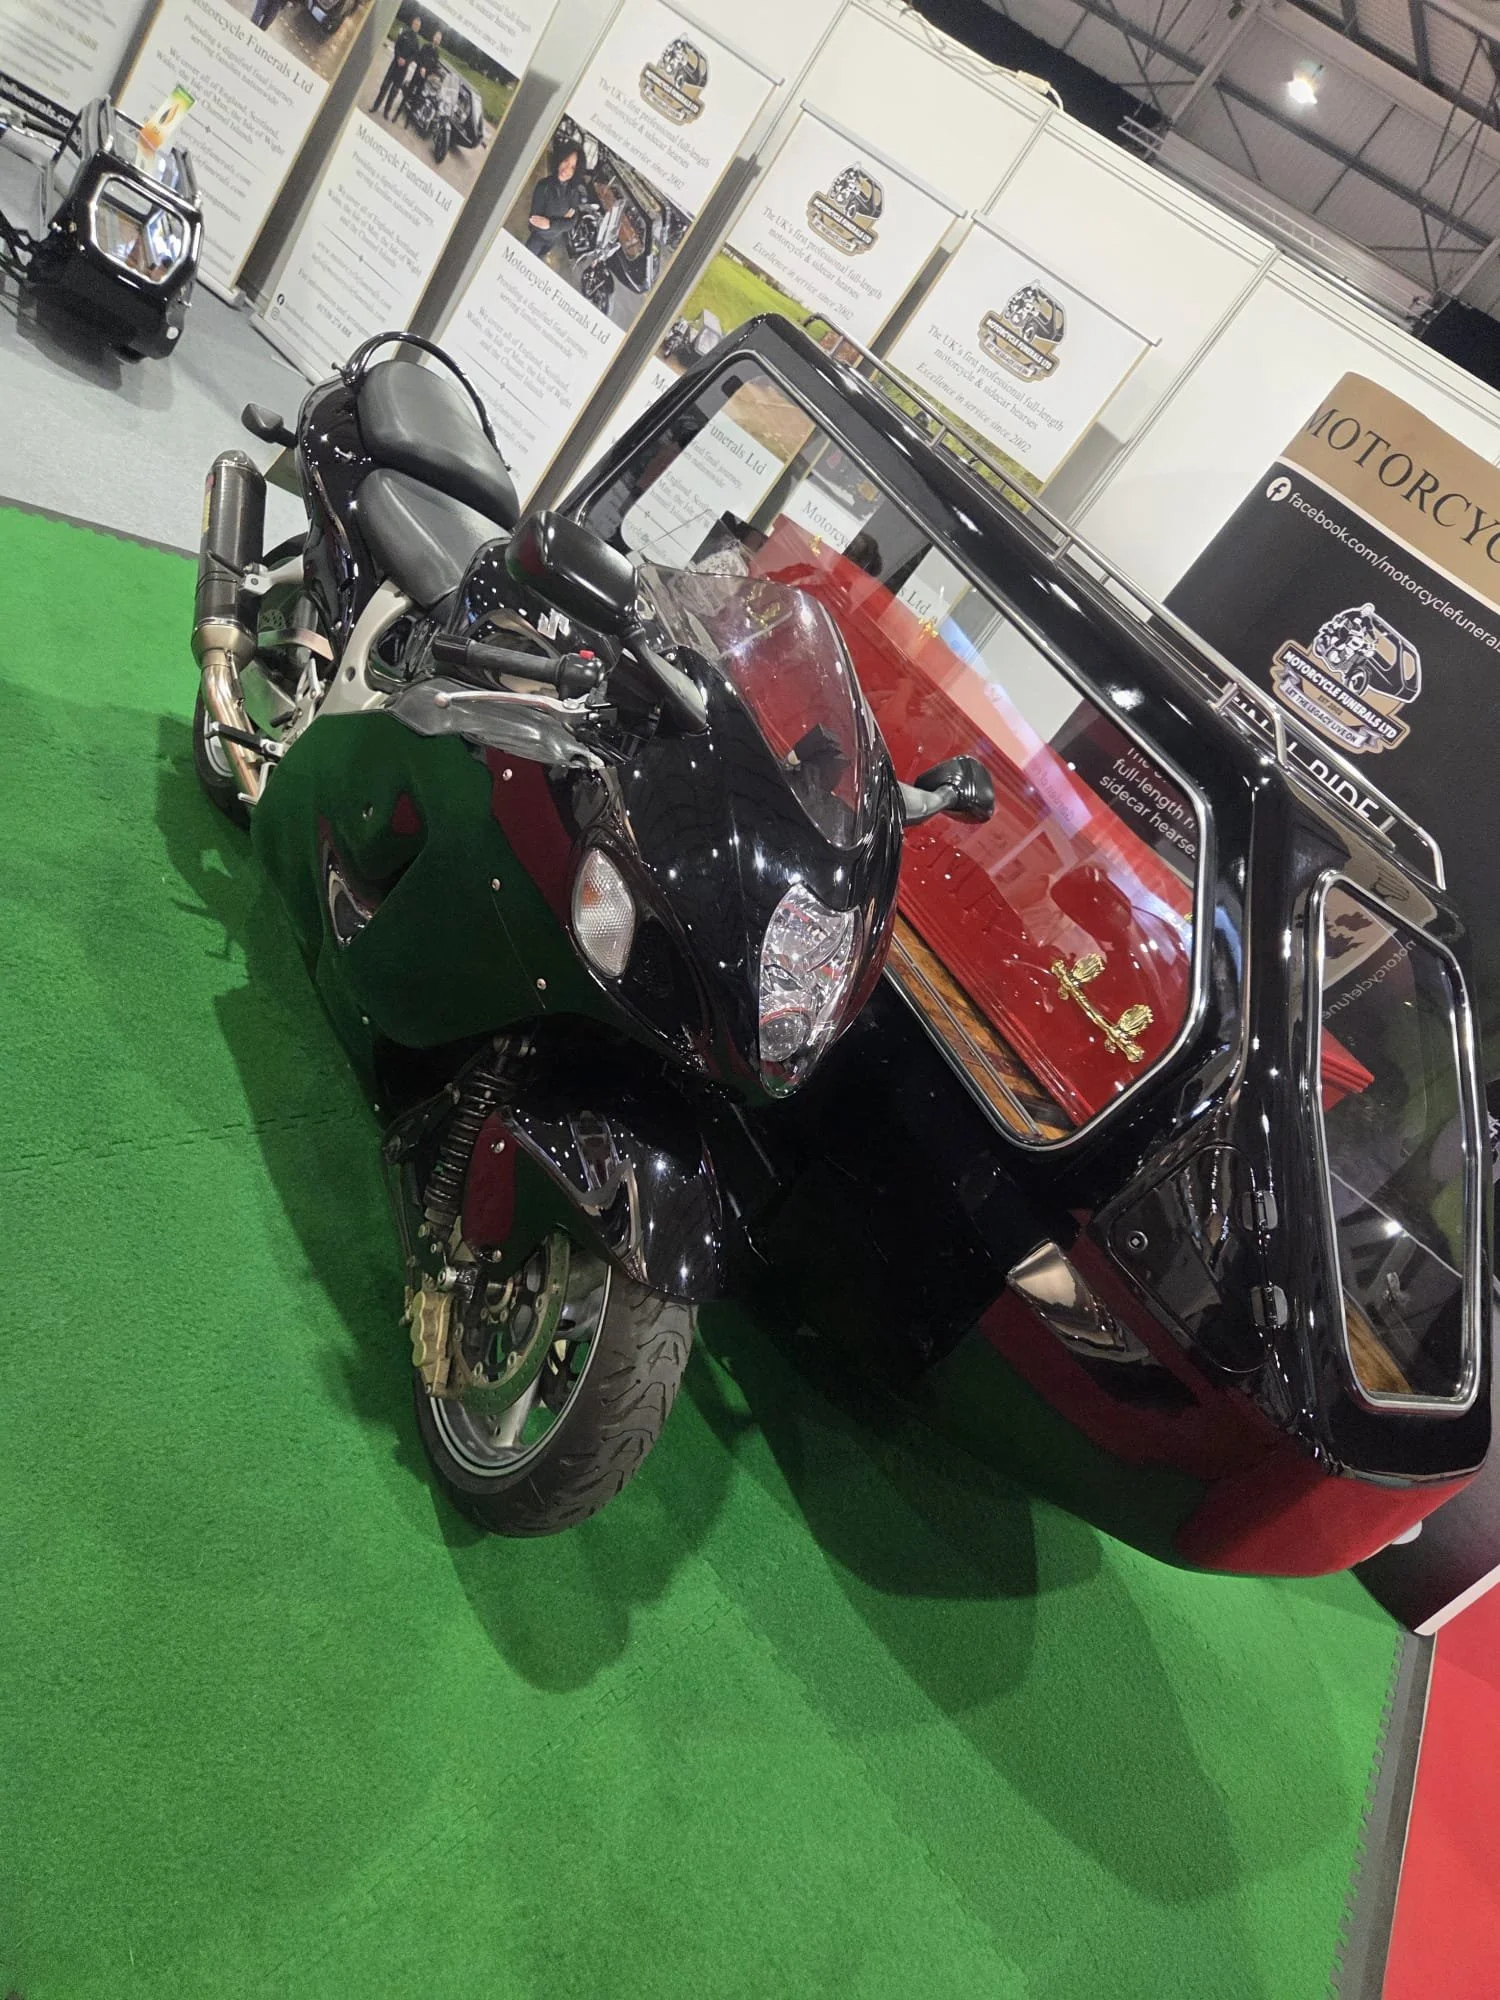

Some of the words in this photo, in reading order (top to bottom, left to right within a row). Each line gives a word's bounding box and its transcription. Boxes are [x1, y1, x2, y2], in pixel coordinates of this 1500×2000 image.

[190, 0, 246, 41] otorcycle
[244, 34, 292, 78] Funerals
[291, 72, 314, 94] Ltd
[354, 124, 401, 168] Motorcycle
[398, 160, 436, 197] Funerals
[433, 190, 453, 212] Ltd
[752, 241, 789, 272] Excellence
[786, 268, 796, 278] in
[794, 274, 818, 294] service
[816, 290, 836, 307] since
[833, 302, 854, 321] 2002
[762, 206, 776, 221] The
[774, 215, 794, 234] UK's
[792, 228, 809, 244] first
[805, 240, 849, 275] professional
[846, 269, 883, 301] full-length
[767, 227, 805, 259] motorcycle
[803, 253, 814, 264] &
[811, 259, 836, 281] sidecar
[833, 276, 860, 300] hearses
[500, 246, 553, 296] Motorcycle
[550, 288, 591, 328] Funerals
[588, 322, 611, 345] Ltd
[927, 323, 943, 340] The
[941, 334, 964, 356] UK's
[961, 350, 980, 368] first
[976, 363, 1026, 402] professional
[1021, 396, 1065, 433] full-length
[985, 318, 1019, 345] MOTORCYCLE
[1016, 341, 1043, 363] FUNERALS
[1040, 358, 1052, 370] LTD
[915, 361, 956, 396] Excellence
[954, 392, 965, 403] in
[962, 399, 991, 423] service
[990, 420, 1011, 438] since
[1008, 433, 1031, 453] 2002
[932, 348, 976, 383] motorcycle
[974, 377, 984, 388] &
[982, 384, 1011, 409] sidecar
[1009, 404, 1039, 430] hearses
[706, 422, 745, 458] unerals
[744, 453, 767, 475] Ltd
[906, 590, 931, 615] Ltd
[1281, 650, 1342, 697] MOTORCYCLE
[1336, 691, 1382, 727] FUNERALS
[1376, 721, 1397, 739] LTD
[1284, 686, 1298, 698] LET
[1295, 694, 1310, 708] THE
[1305, 703, 1333, 725] LEGACY
[1330, 721, 1347, 736] LIVE
[1344, 730, 1357, 742] ON
[1097, 774, 1152, 817] sidecar
[1109, 758, 1187, 820] full-length
